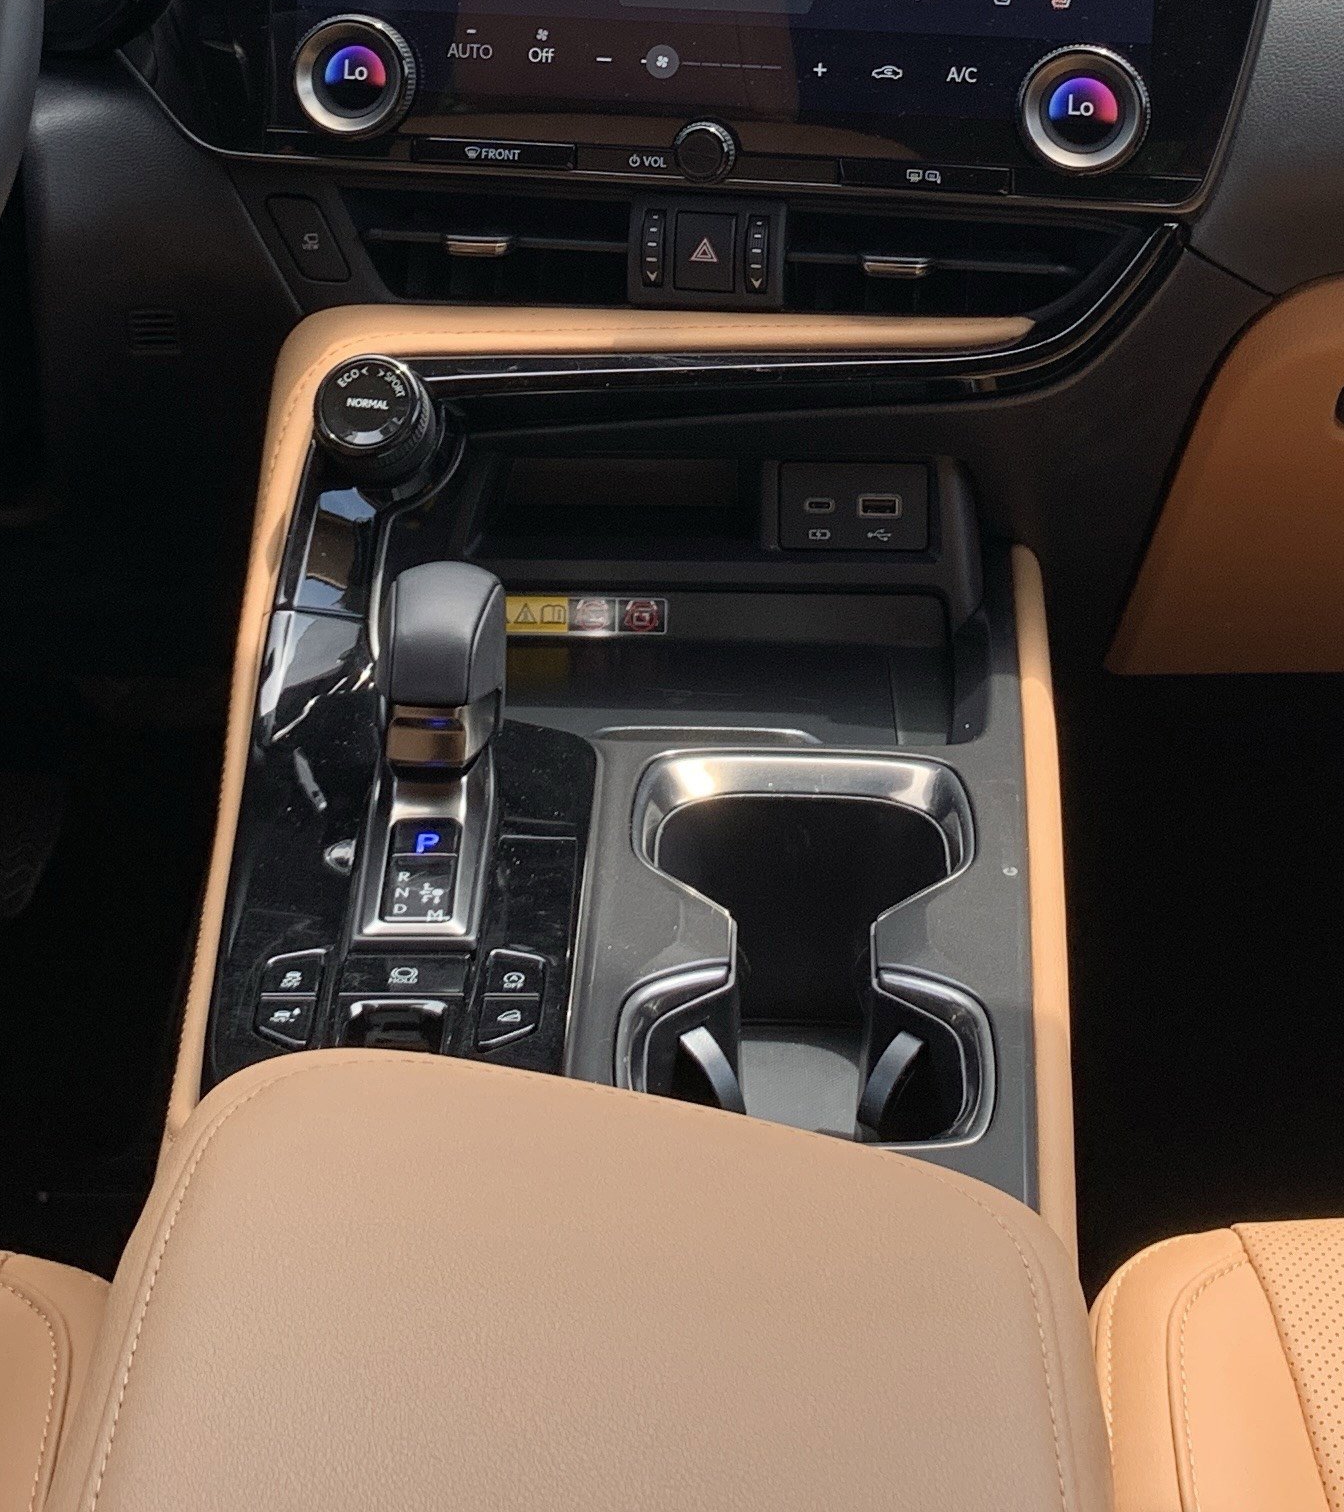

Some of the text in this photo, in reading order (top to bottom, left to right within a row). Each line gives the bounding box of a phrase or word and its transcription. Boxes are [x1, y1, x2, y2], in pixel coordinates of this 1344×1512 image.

[446, 42, 494, 61] AUTO
[528, 46, 555, 64] Off
[343, 58, 368, 82] Lo
[946, 66, 979, 84] A/C
[1067, 93, 1095, 117] Lo
[480, 148, 522, 162] FRONT
[642, 155, 668, 169] VOL
[336, 368, 361, 388] ECO
[383, 371, 406, 398] SPORT
[346, 396, 390, 411] NORMAL
[416, 832, 440, 854] P
[398, 871, 411, 882] R
[394, 887, 411, 899] N
[393, 903, 408, 915] D
[426, 908, 444, 923] M
